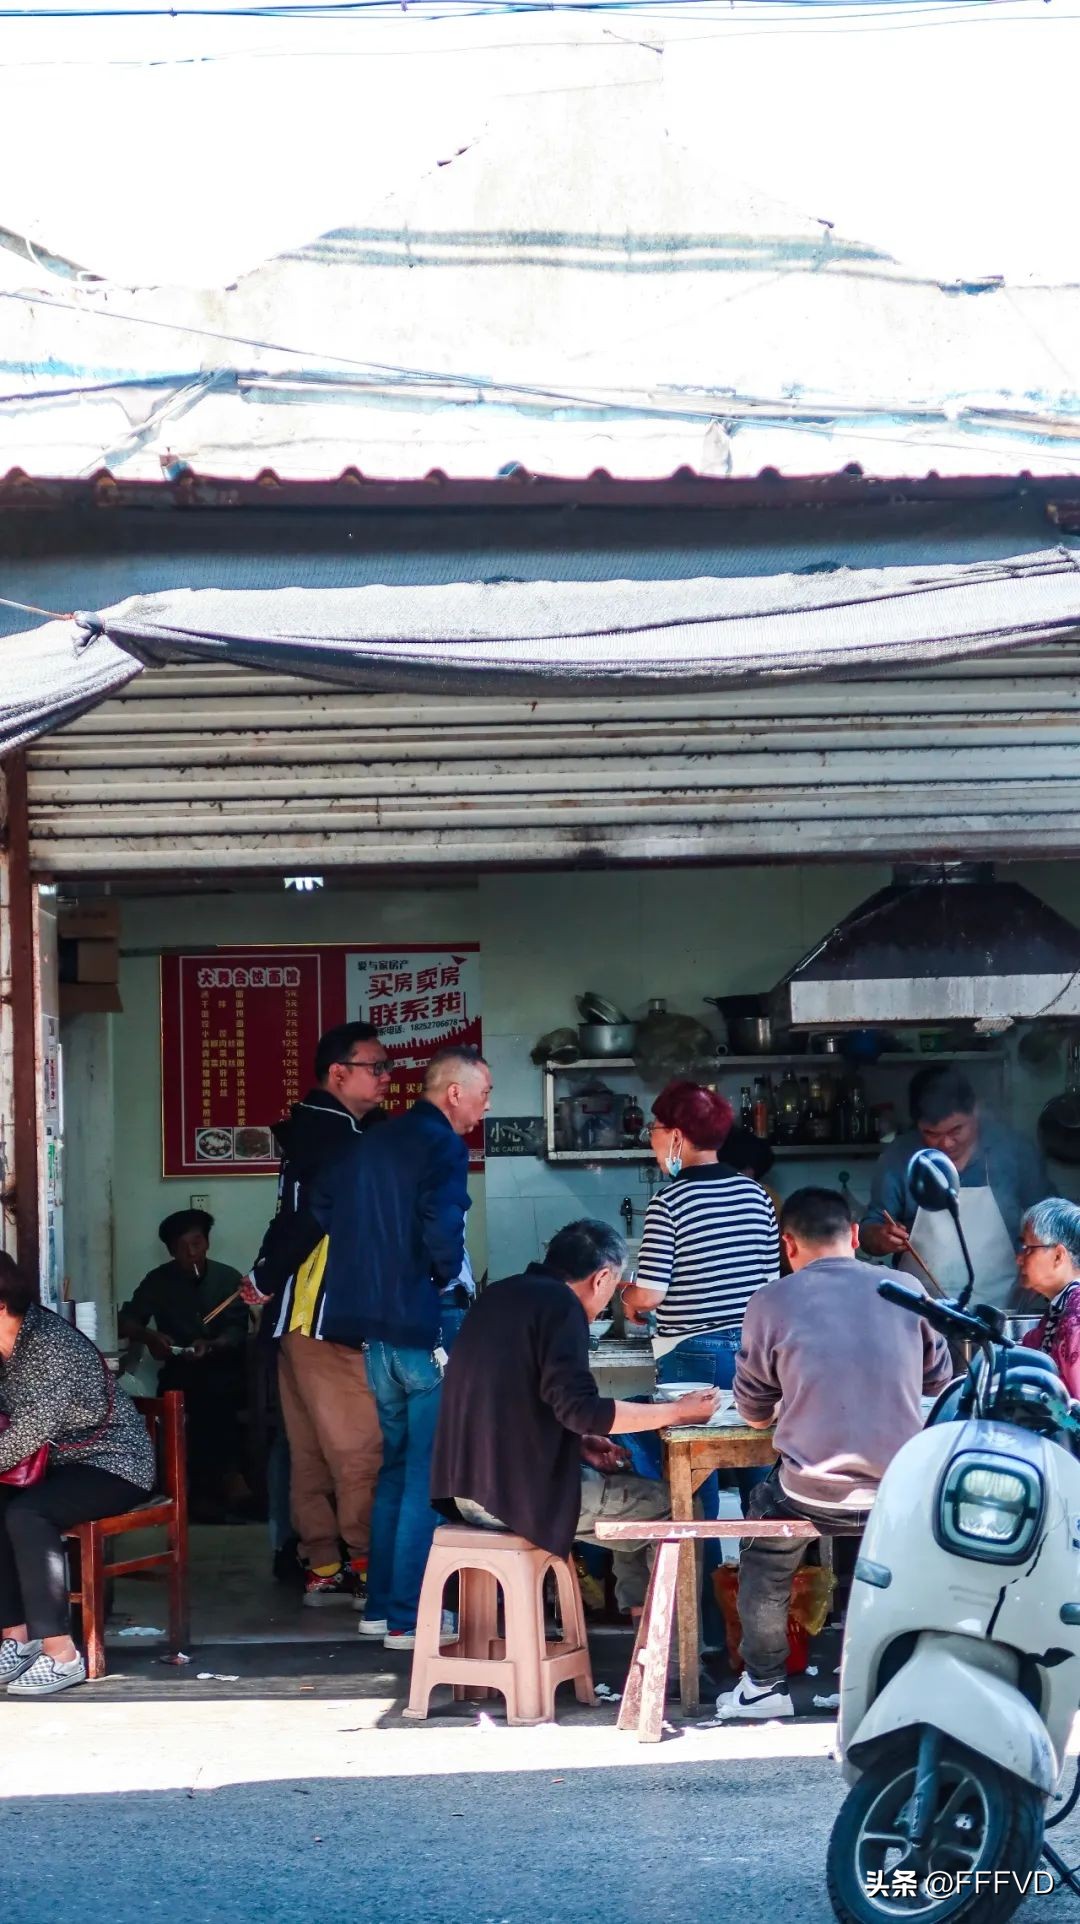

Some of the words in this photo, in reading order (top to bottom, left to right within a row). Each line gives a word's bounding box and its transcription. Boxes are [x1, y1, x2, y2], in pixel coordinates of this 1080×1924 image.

[368, 966, 460, 1000] 买房卖房
[369, 991, 461, 1028] 联系我
[377, 1025, 405, 1036] 系电话：
[410, 1018, 458, 1032] 18252706678
[282, 1059, 299, 1068] 12元
[286, 1068, 299, 1077] 9元
[282, 1079, 299, 1087] 12元
